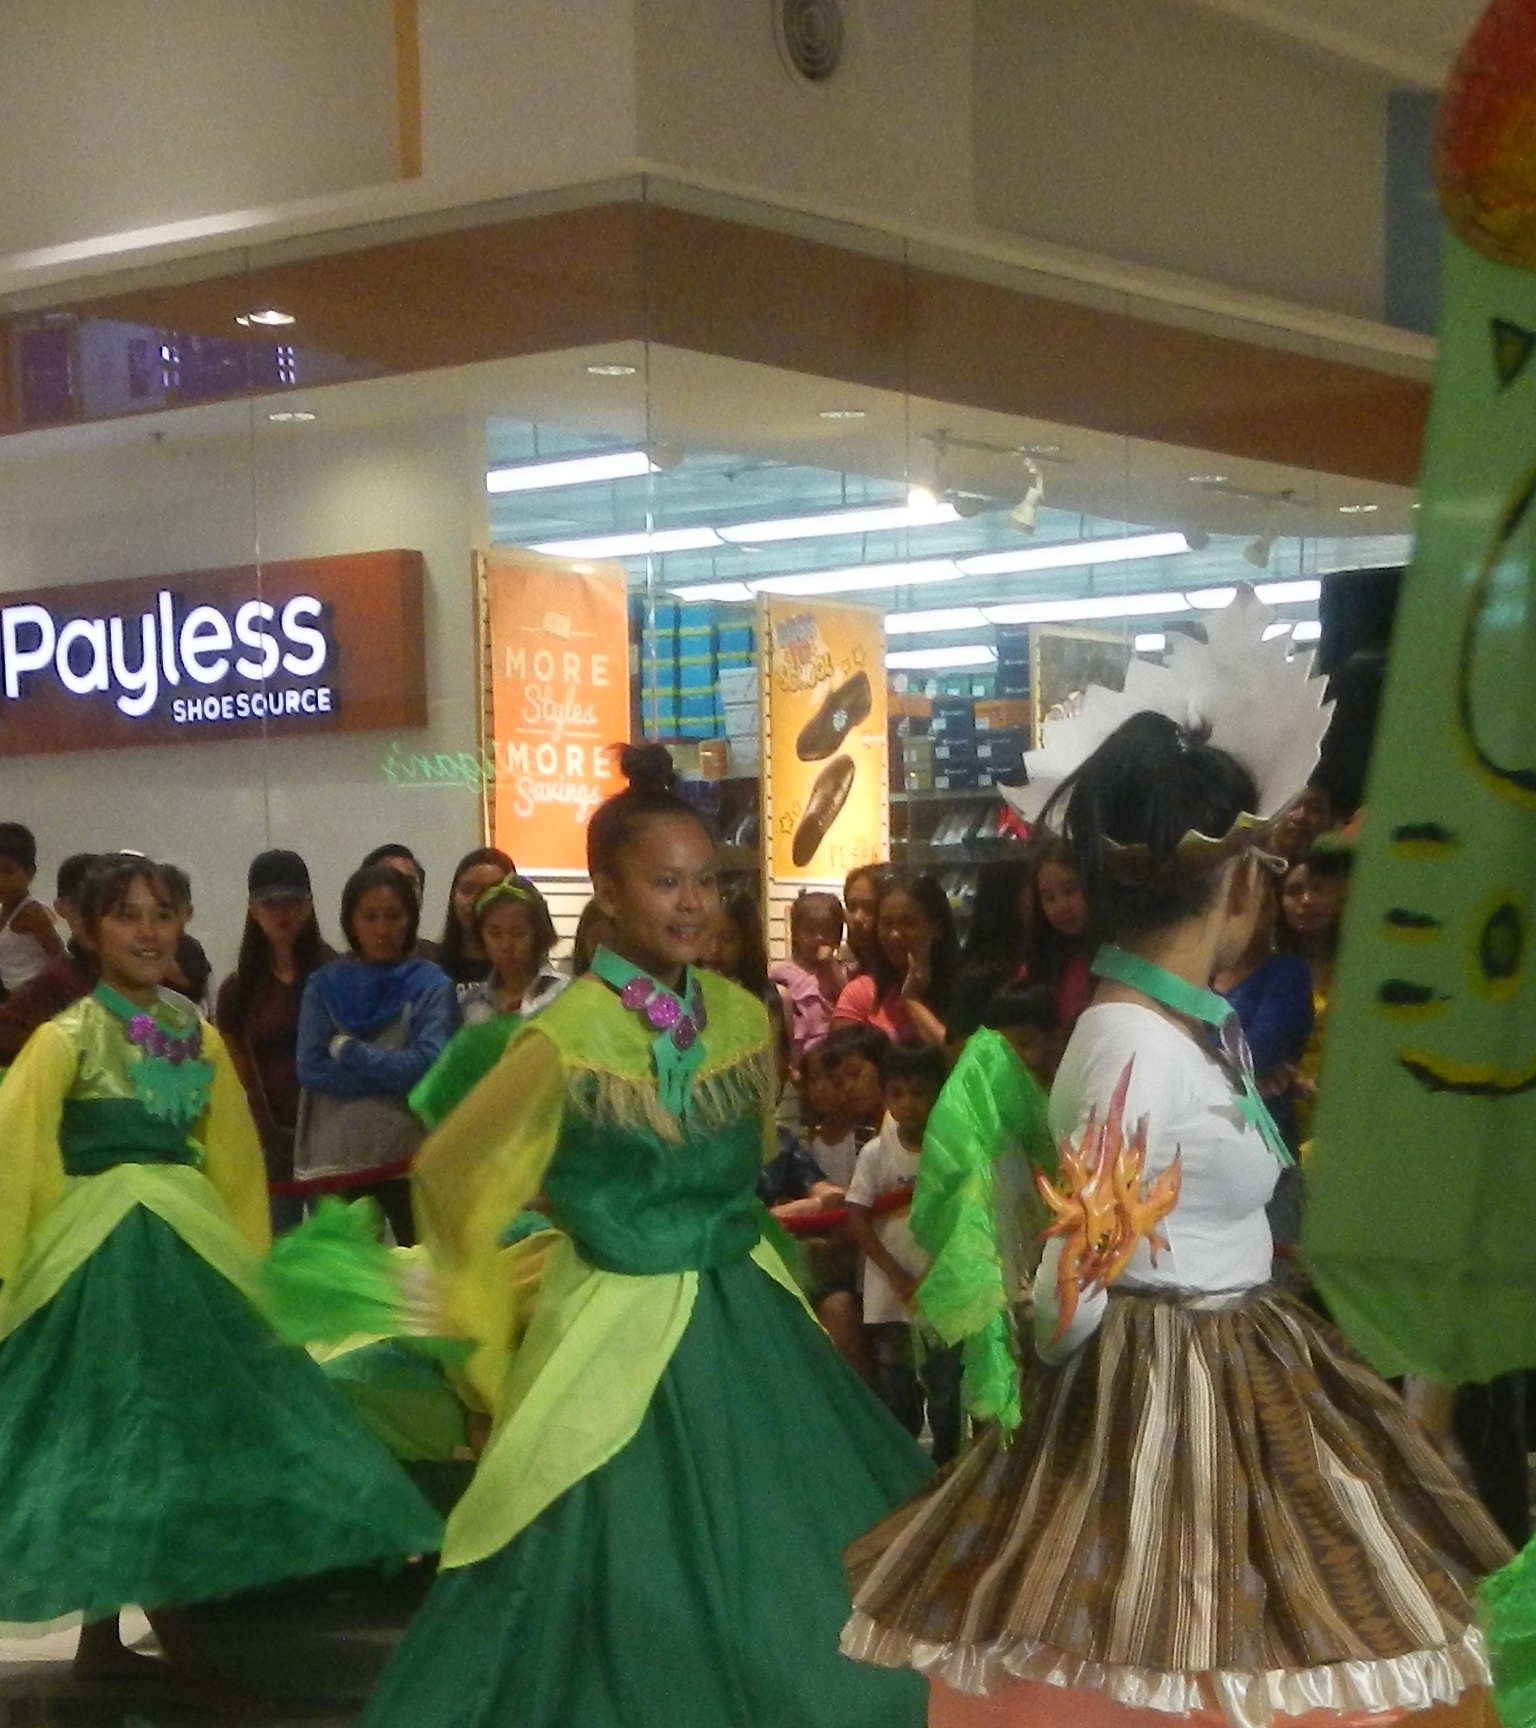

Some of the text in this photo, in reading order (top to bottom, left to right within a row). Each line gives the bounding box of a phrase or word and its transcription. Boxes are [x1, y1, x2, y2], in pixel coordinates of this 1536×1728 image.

[1, 590, 327, 717] Payless
[505, 646, 611, 687] MORE
[522, 682, 598, 742] Styles
[507, 740, 612, 779] MORE
[514, 775, 607, 823] Savings
